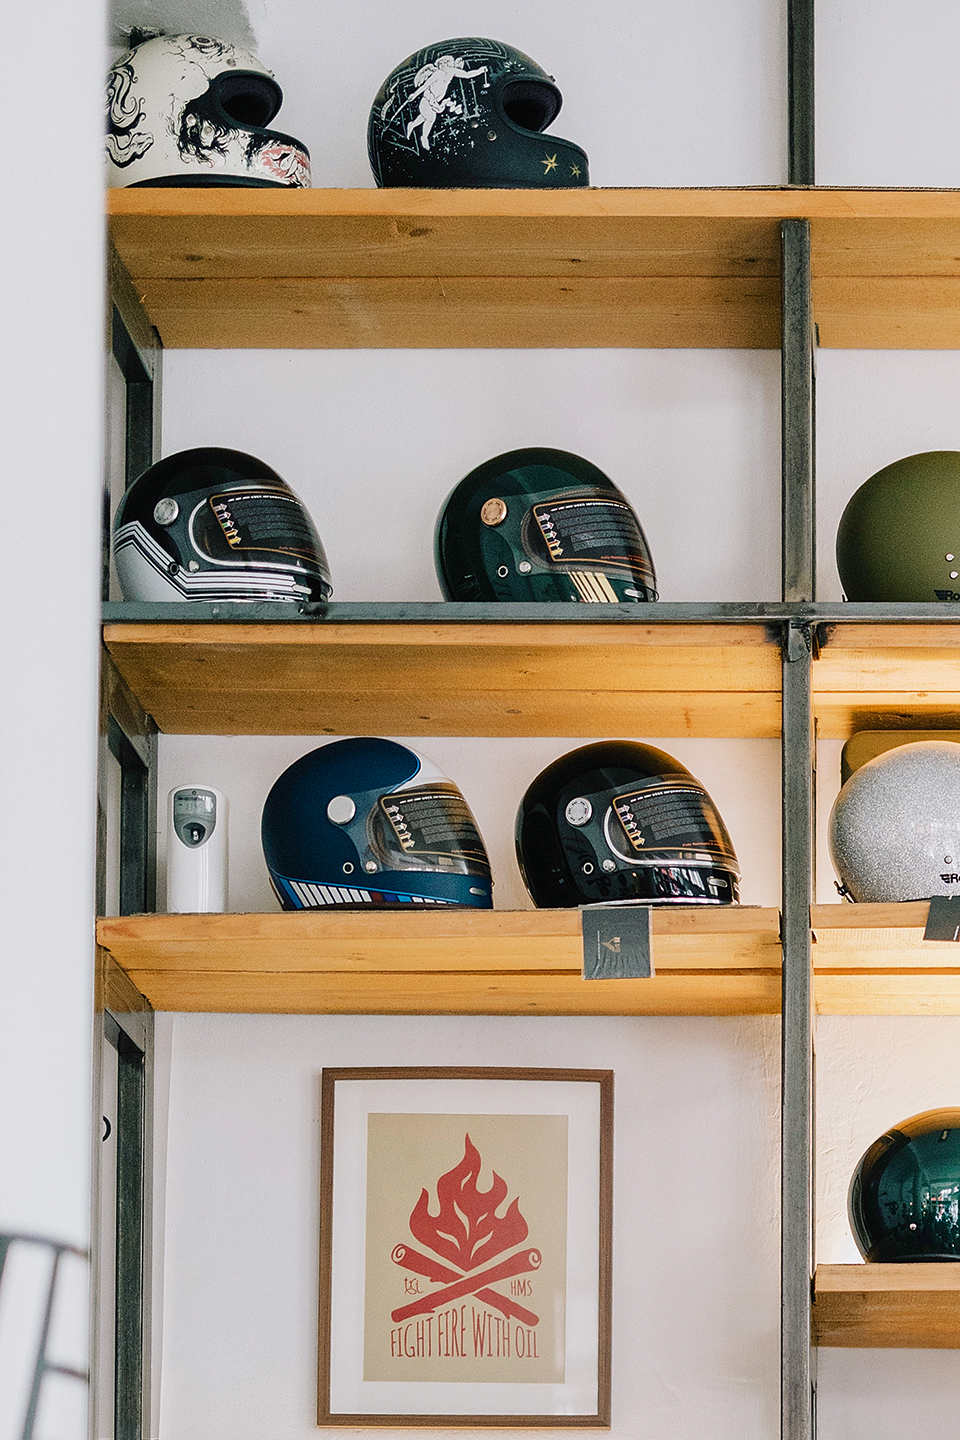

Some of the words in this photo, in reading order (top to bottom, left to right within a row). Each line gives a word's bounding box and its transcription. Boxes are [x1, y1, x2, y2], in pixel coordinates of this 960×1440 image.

[510, 1279, 533, 1297] HMS
[390, 1316, 434, 1358] FIGHT
[438, 1304, 467, 1357] FIRE
[472, 1306, 511, 1358] WITH
[515, 1325, 540, 1358] OIL
